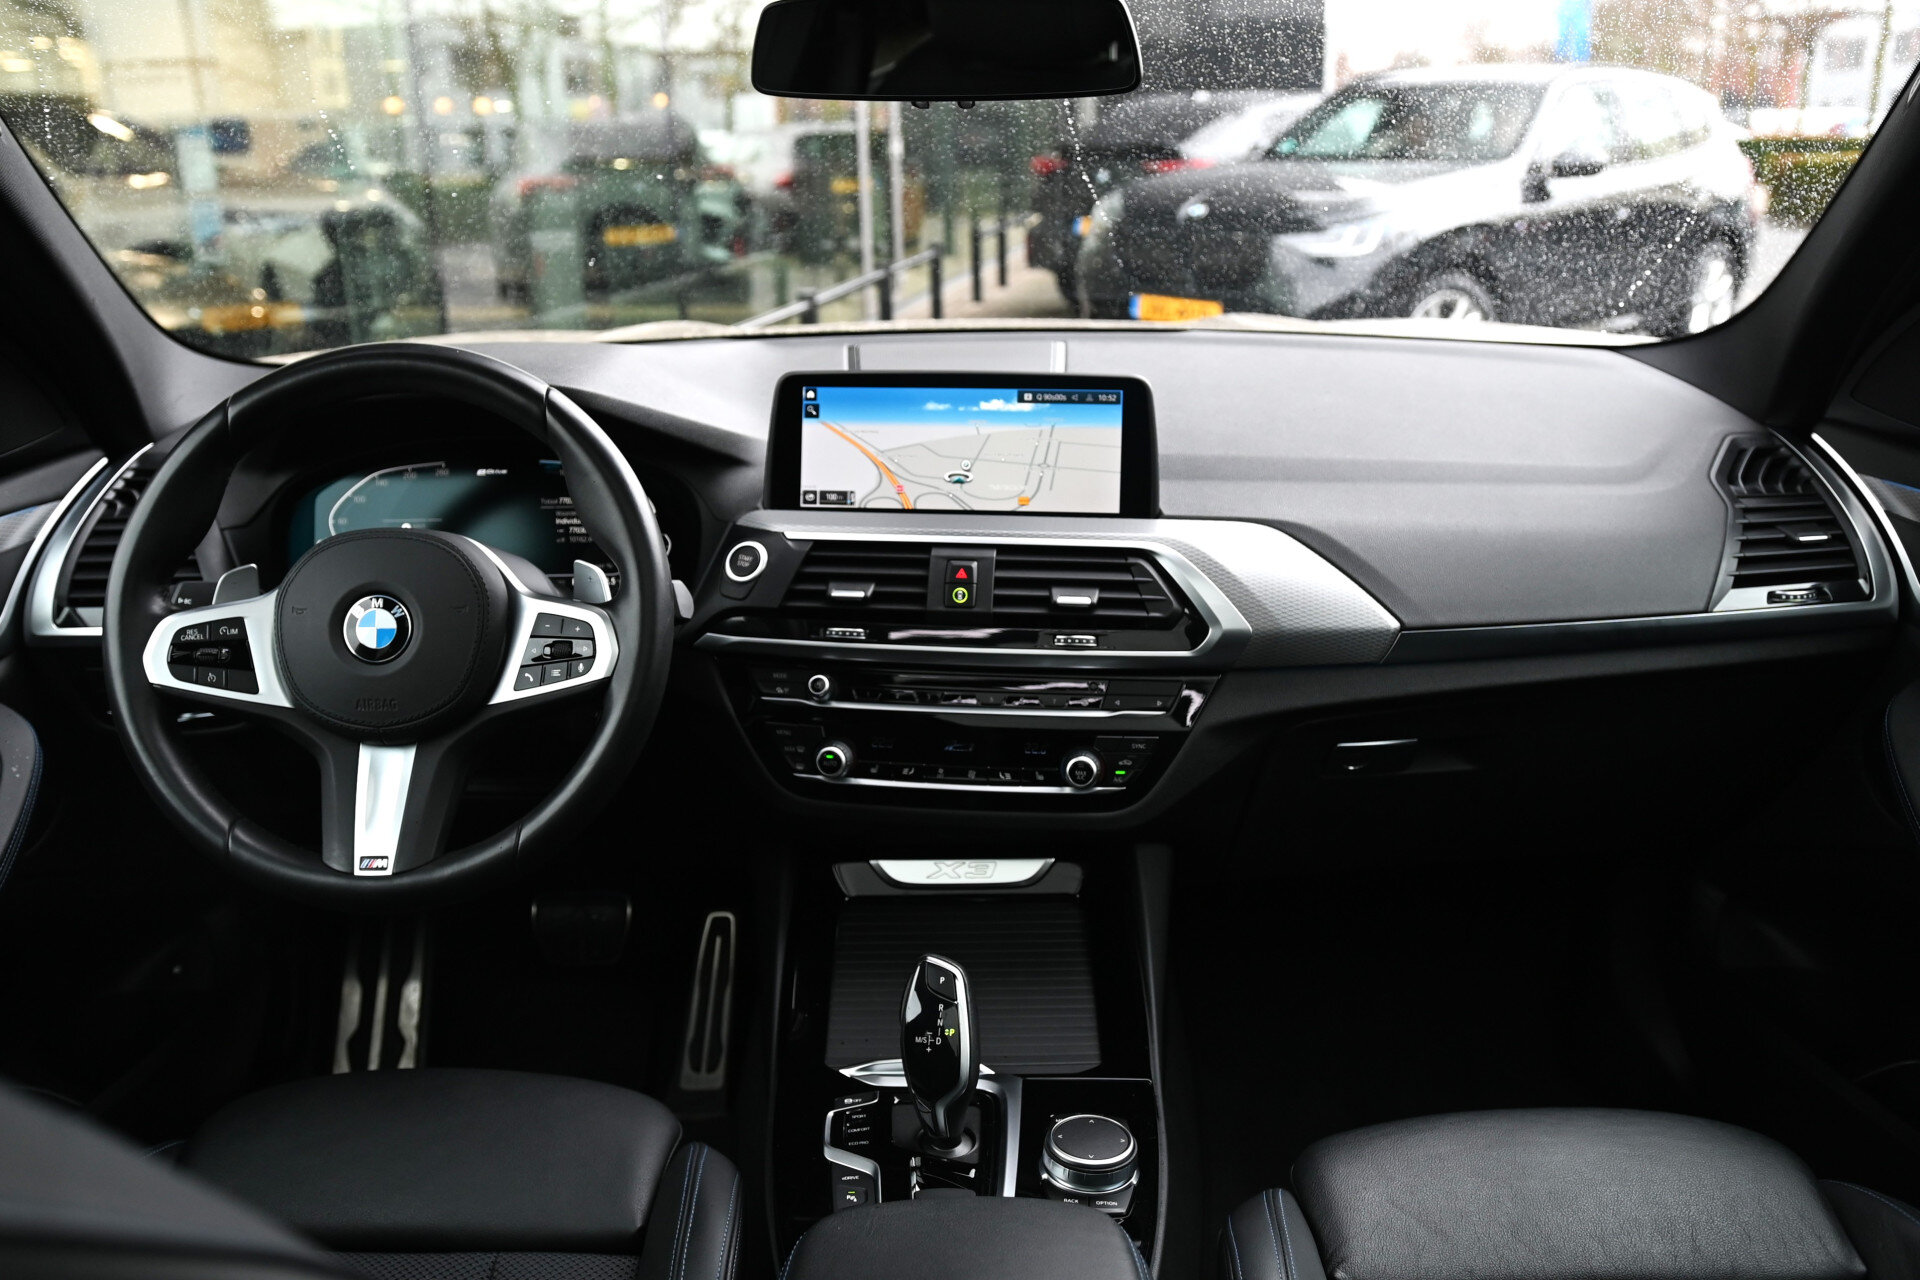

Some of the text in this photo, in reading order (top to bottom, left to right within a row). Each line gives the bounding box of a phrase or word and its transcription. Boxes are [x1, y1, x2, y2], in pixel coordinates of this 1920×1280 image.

[1098, 394, 1117, 402] 10:52
[350, 598, 405, 619] BMW
[227, 628, 239, 636] LIM
[355, 698, 399, 712] AIRBAG
[926, 860, 997, 880] X3
[939, 976, 946, 984] P
[938, 1003, 944, 1012] R
[937, 1018, 944, 1027] N
[915, 1036, 928, 1044] M/S
[935, 1037, 942, 1045] D
